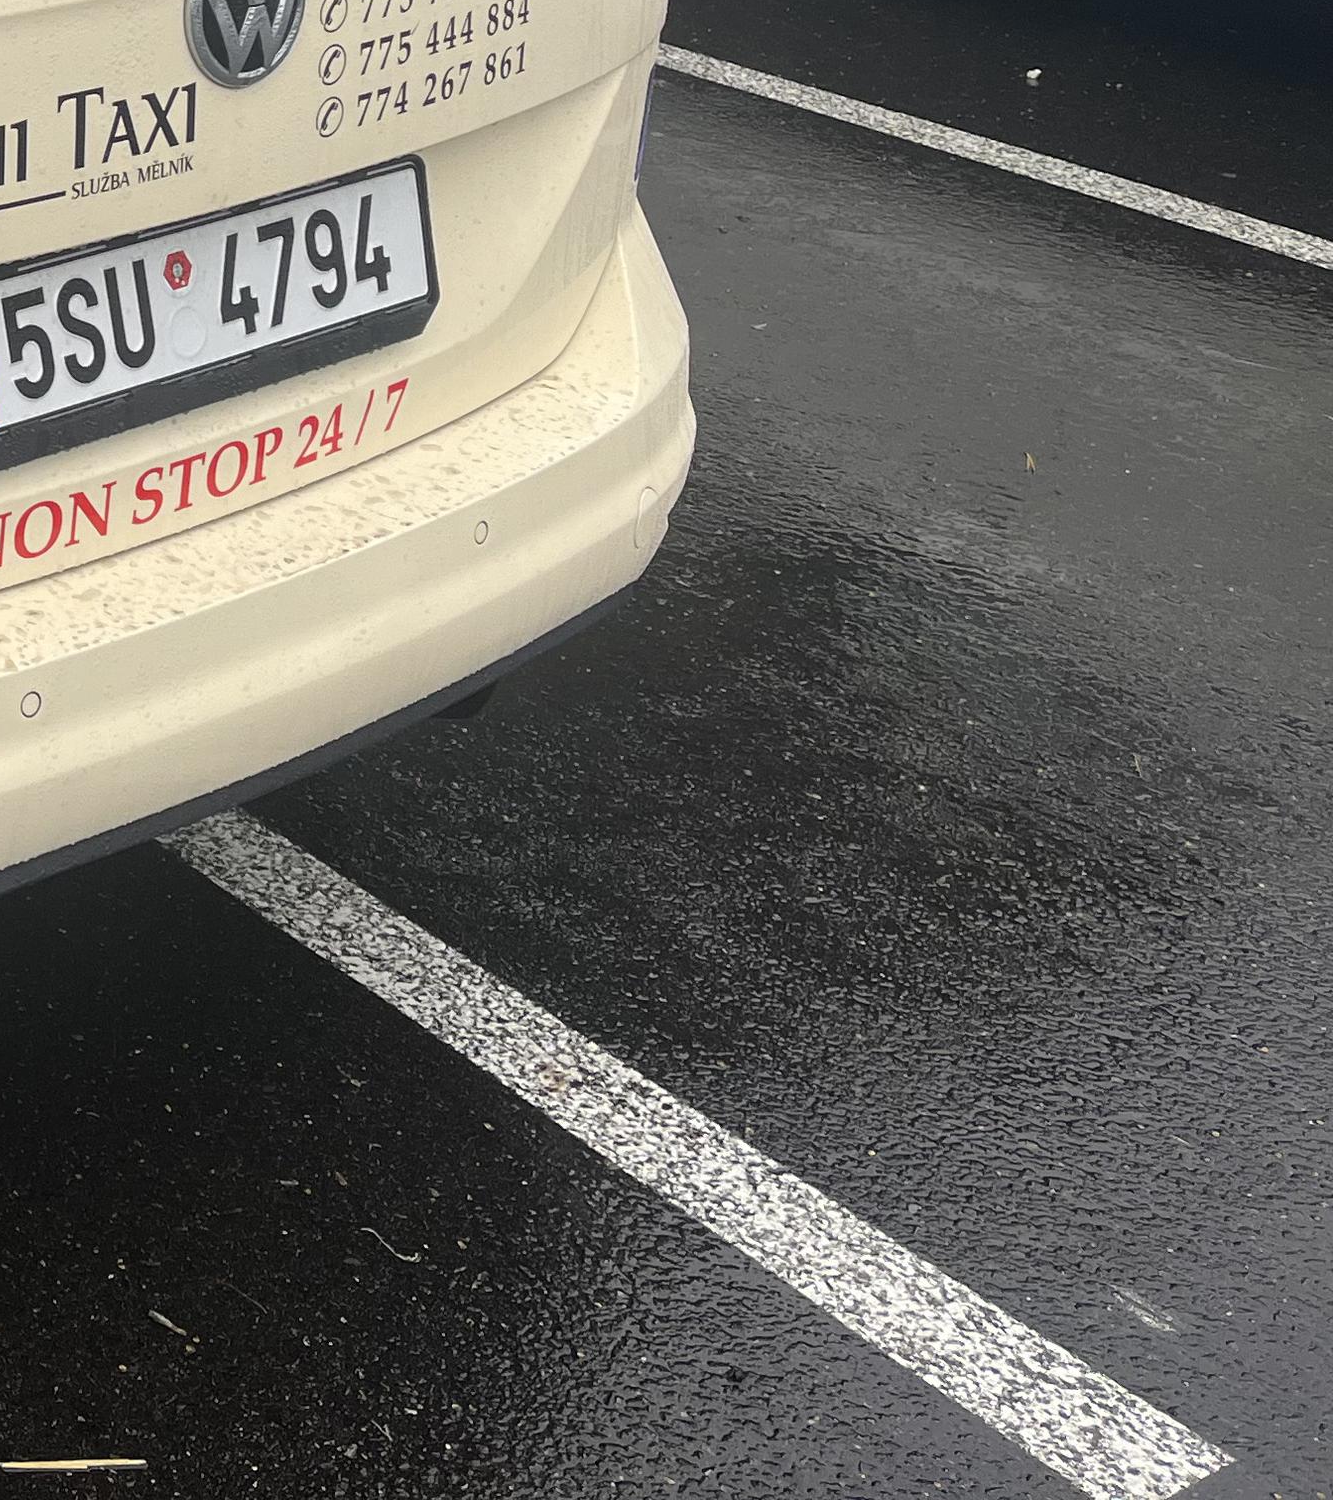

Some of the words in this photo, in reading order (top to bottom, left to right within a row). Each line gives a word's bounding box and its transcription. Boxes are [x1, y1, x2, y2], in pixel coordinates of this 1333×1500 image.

[357, 81, 408, 127] 774
[422, 60, 473, 107] 267
[483, 41, 527, 86] 861
[359, 29, 412, 76] 775
[425, 10, 474, 55] 444
[57, 81, 197, 171] TAXI
[71, 171, 130, 200] SLUŽBA
[137, 153, 194, 184] MĚLNÍK
[0, 258, 157, 399] 5SU
[220, 193, 392, 336] 4794
[131, 425, 284, 525] STOP
